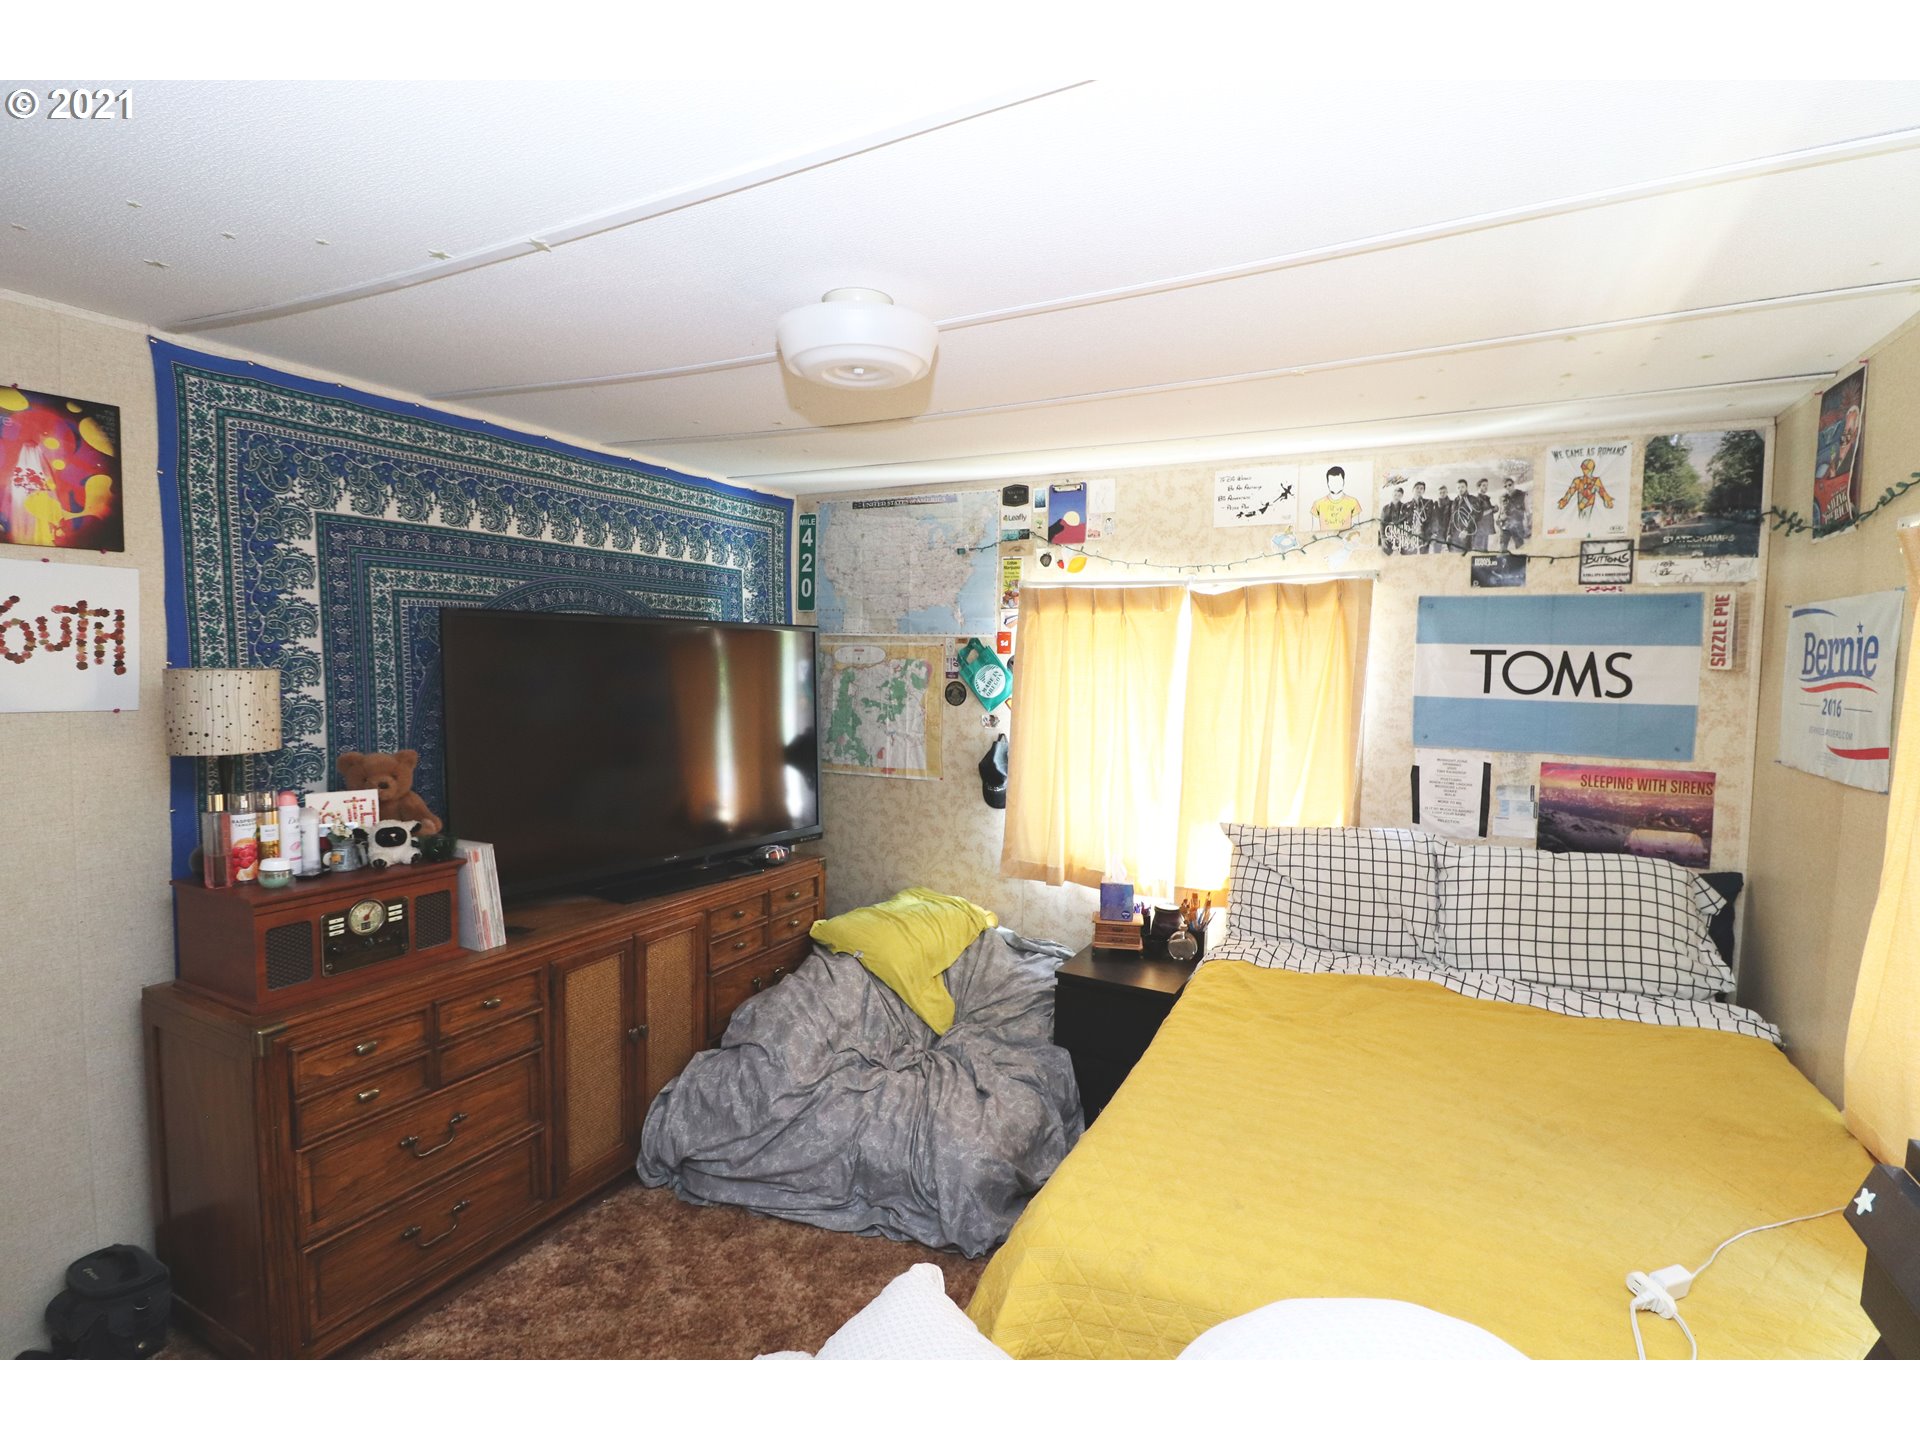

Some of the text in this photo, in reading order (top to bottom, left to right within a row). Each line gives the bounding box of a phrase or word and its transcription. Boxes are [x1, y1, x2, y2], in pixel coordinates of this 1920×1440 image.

[1552, 445, 1627, 462] WE CAME AS ROMANS
[1008, 513, 1027, 522] Leafly
[1711, 594, 1731, 666] SIZZLE PIE
[1802, 622, 1880, 678] Bernie
[985, 673, 1004, 697] OREGON
[1470, 650, 1634, 699] TOMS
[1821, 698, 1842, 718] 2016
[1580, 774, 1714, 796] SLEEPING WITH SIRENS
